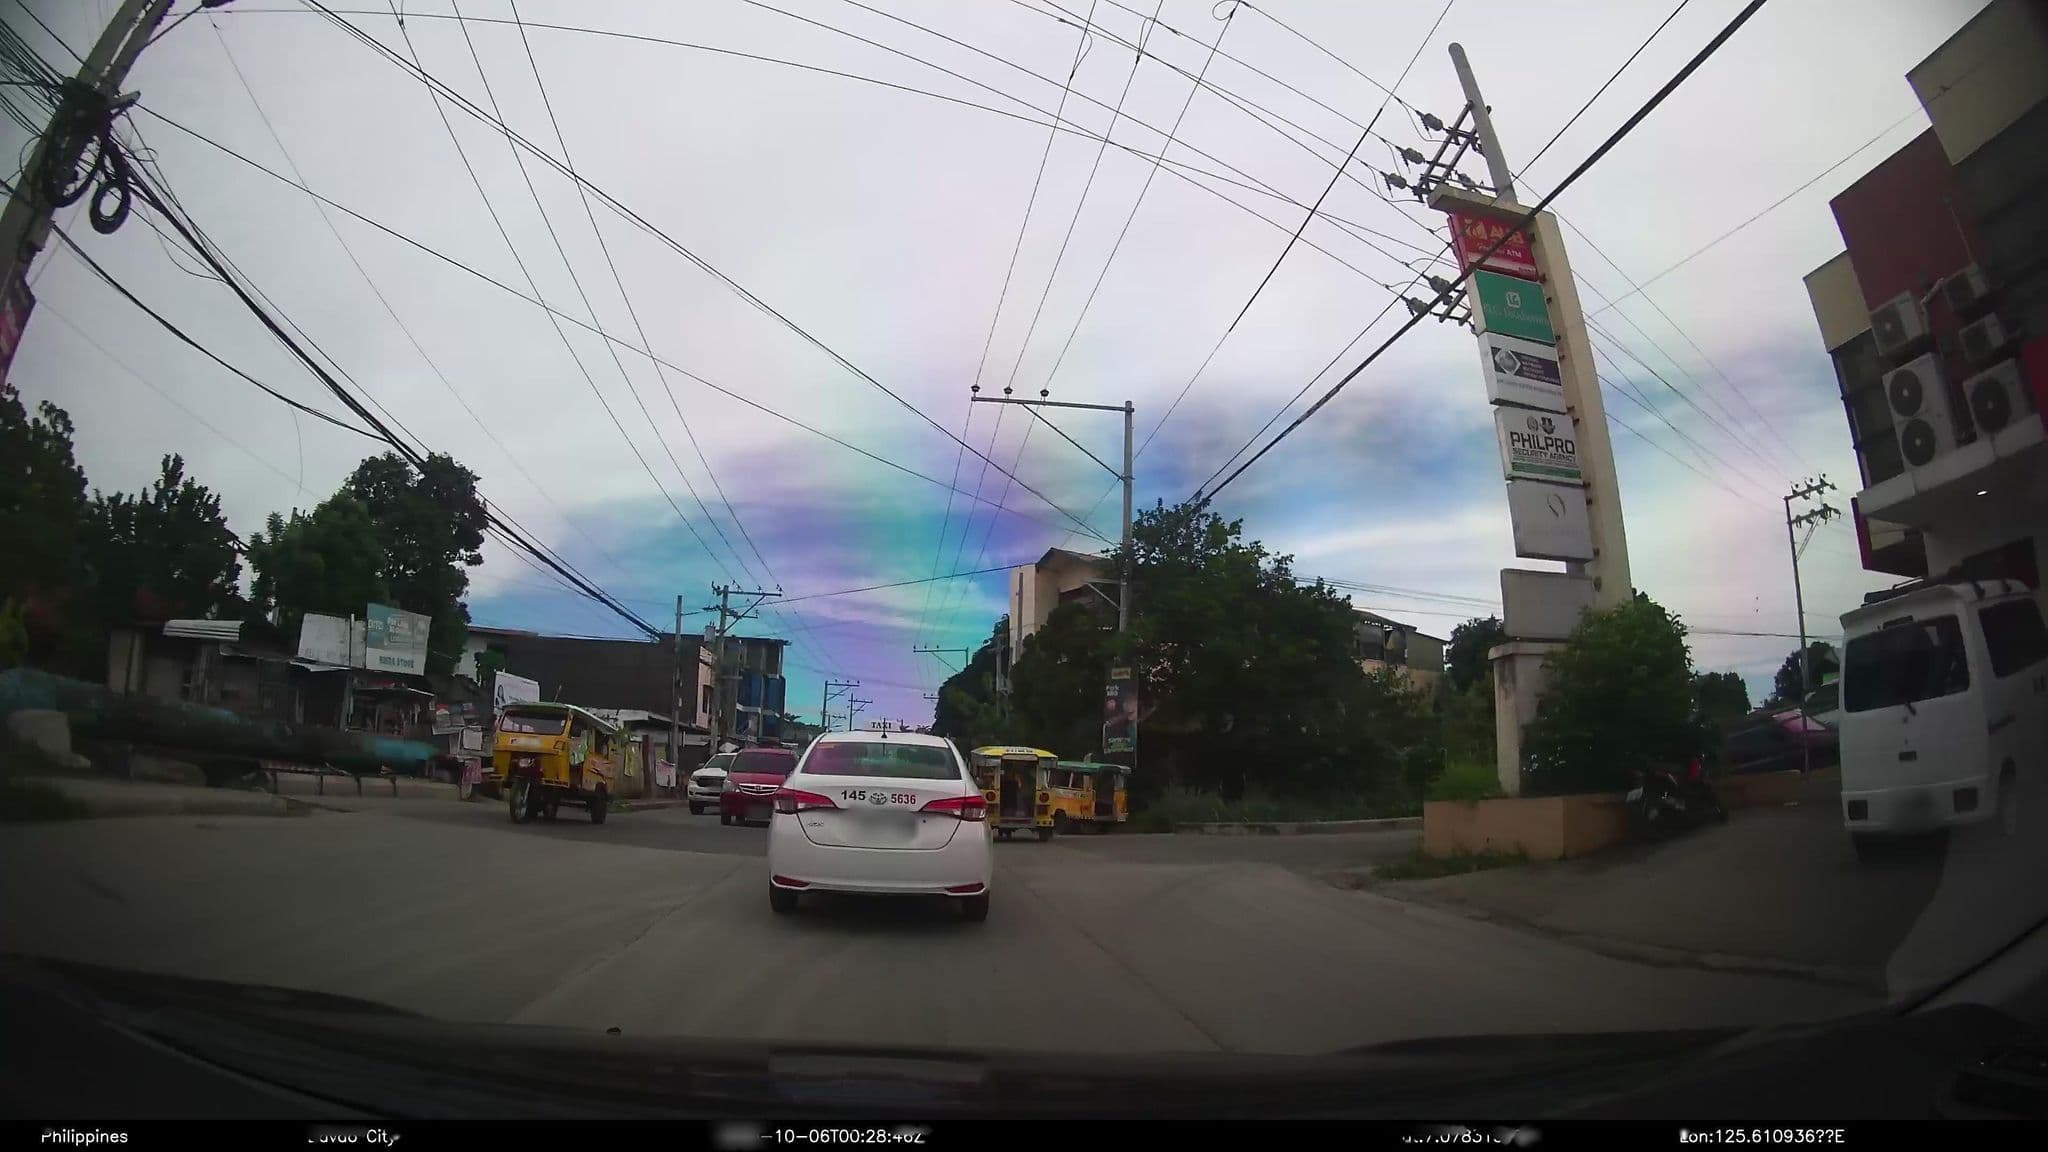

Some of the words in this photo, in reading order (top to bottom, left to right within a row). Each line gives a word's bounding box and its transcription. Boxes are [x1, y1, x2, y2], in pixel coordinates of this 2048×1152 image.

[1510, 431, 1575, 455] PHILPRO
[1512, 447, 1549, 458] SECURITY
[871, 721, 892, 729] TAXI
[841, 790, 866, 801] 145
[890, 793, 917, 804] 5636
